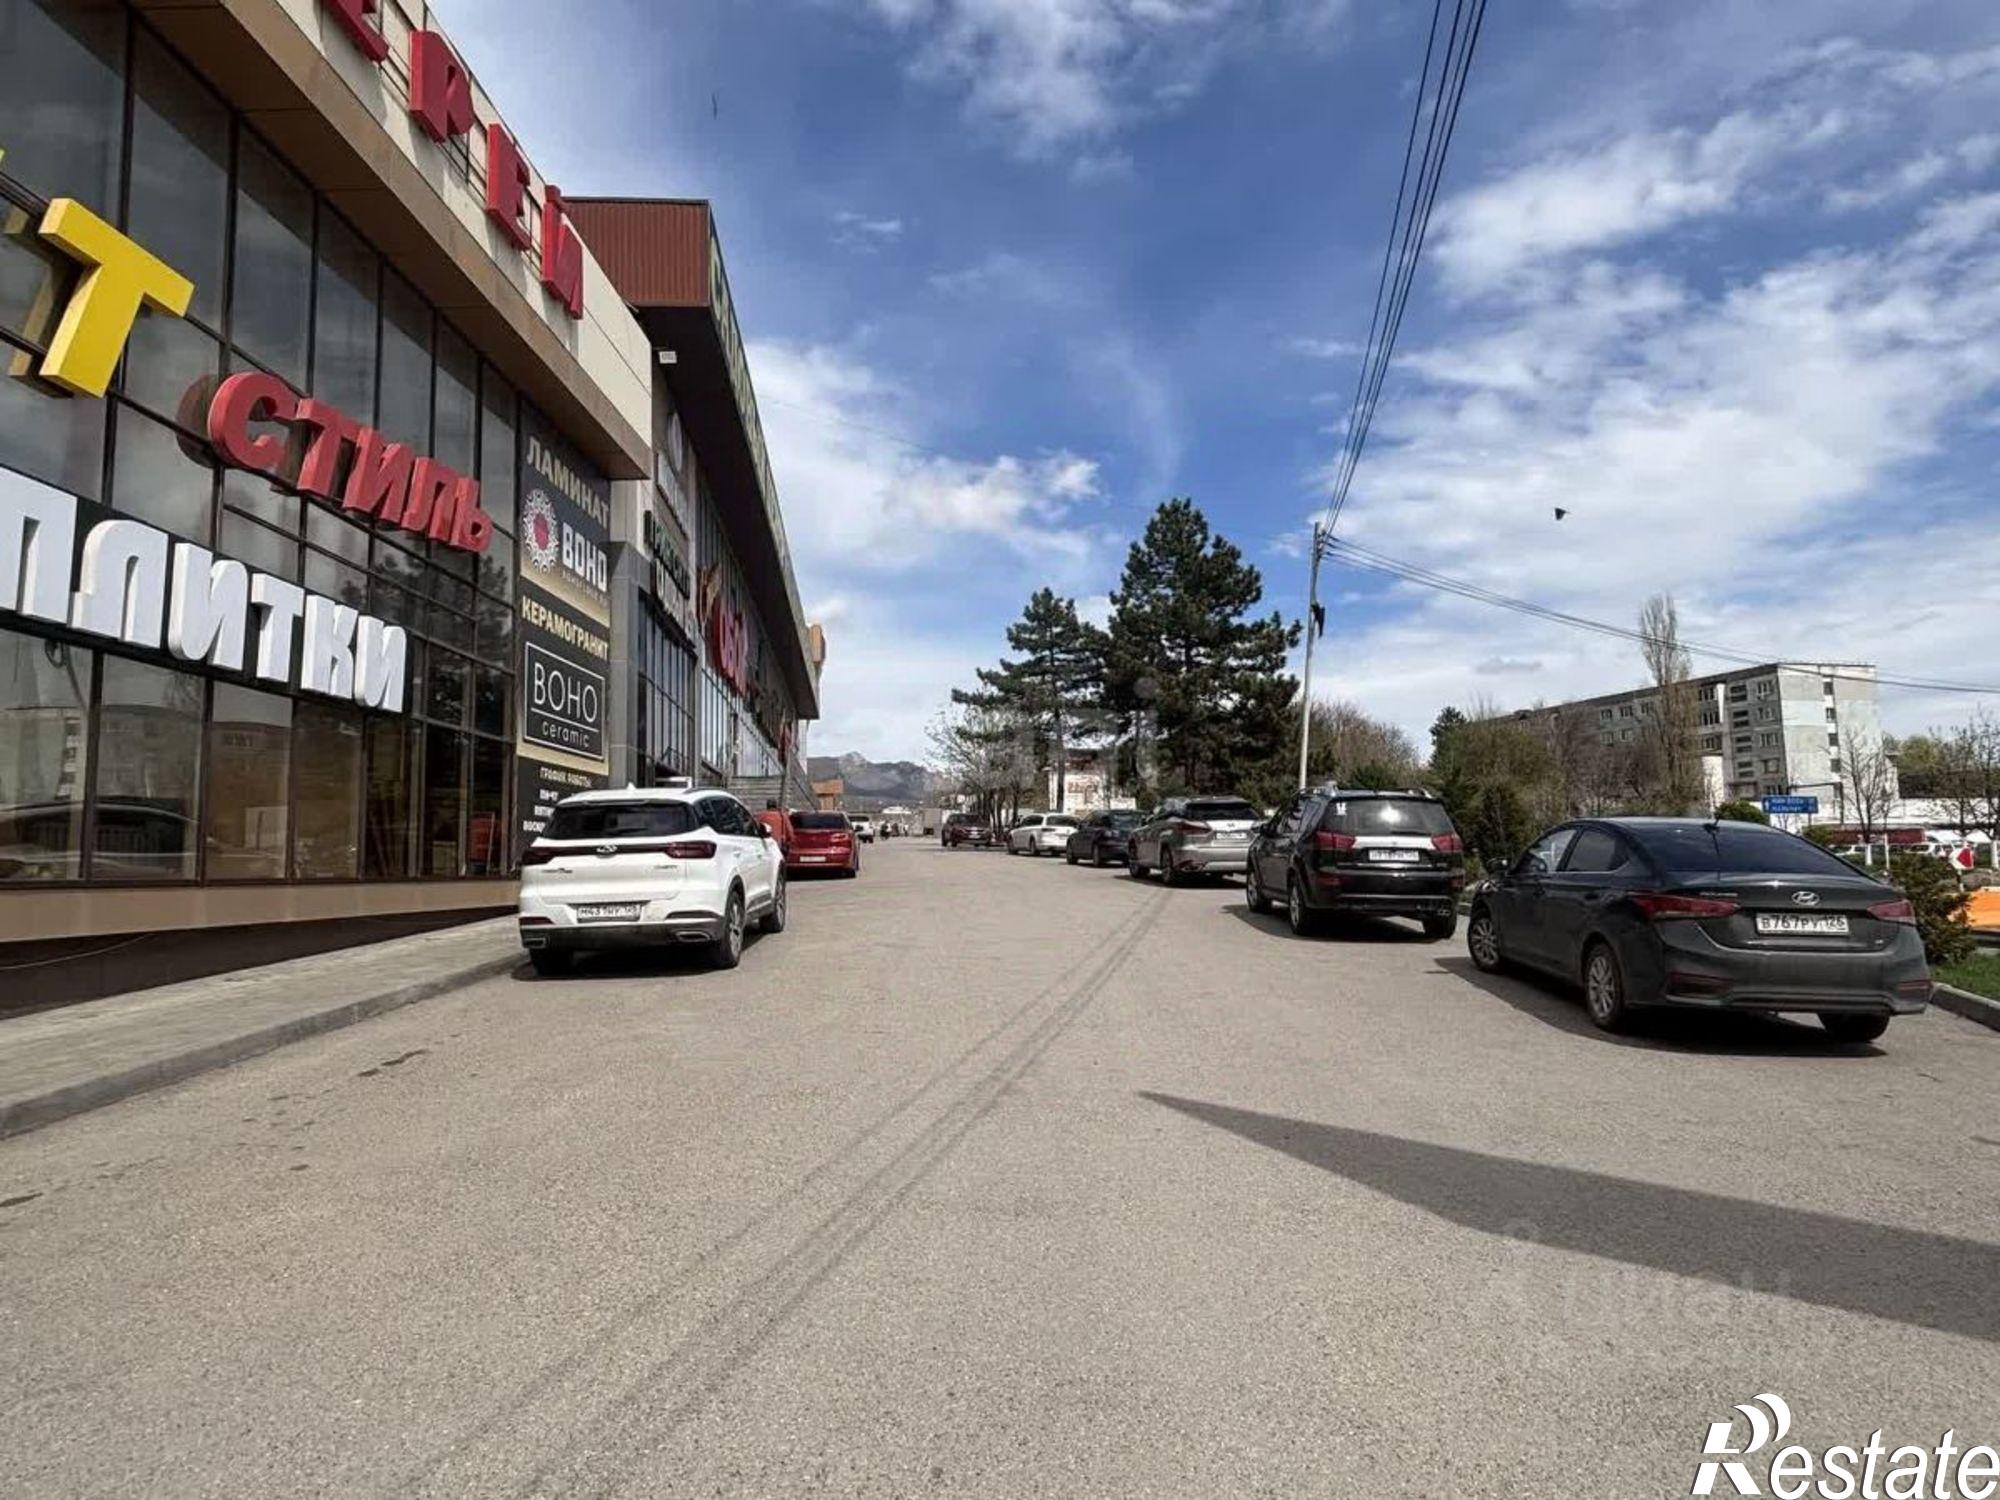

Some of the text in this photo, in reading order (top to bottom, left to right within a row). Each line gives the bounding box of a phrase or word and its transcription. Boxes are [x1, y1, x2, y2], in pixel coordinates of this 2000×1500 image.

[207, 371, 493, 553] СТИЛЬ
[526, 436, 609, 529] ЛАМИНАТ
[0, 465, 407, 713] ПЛИТКИ
[522, 595, 609, 661] КЕРАМОГРАНИТ
[541, 721, 590, 748] ceramic
